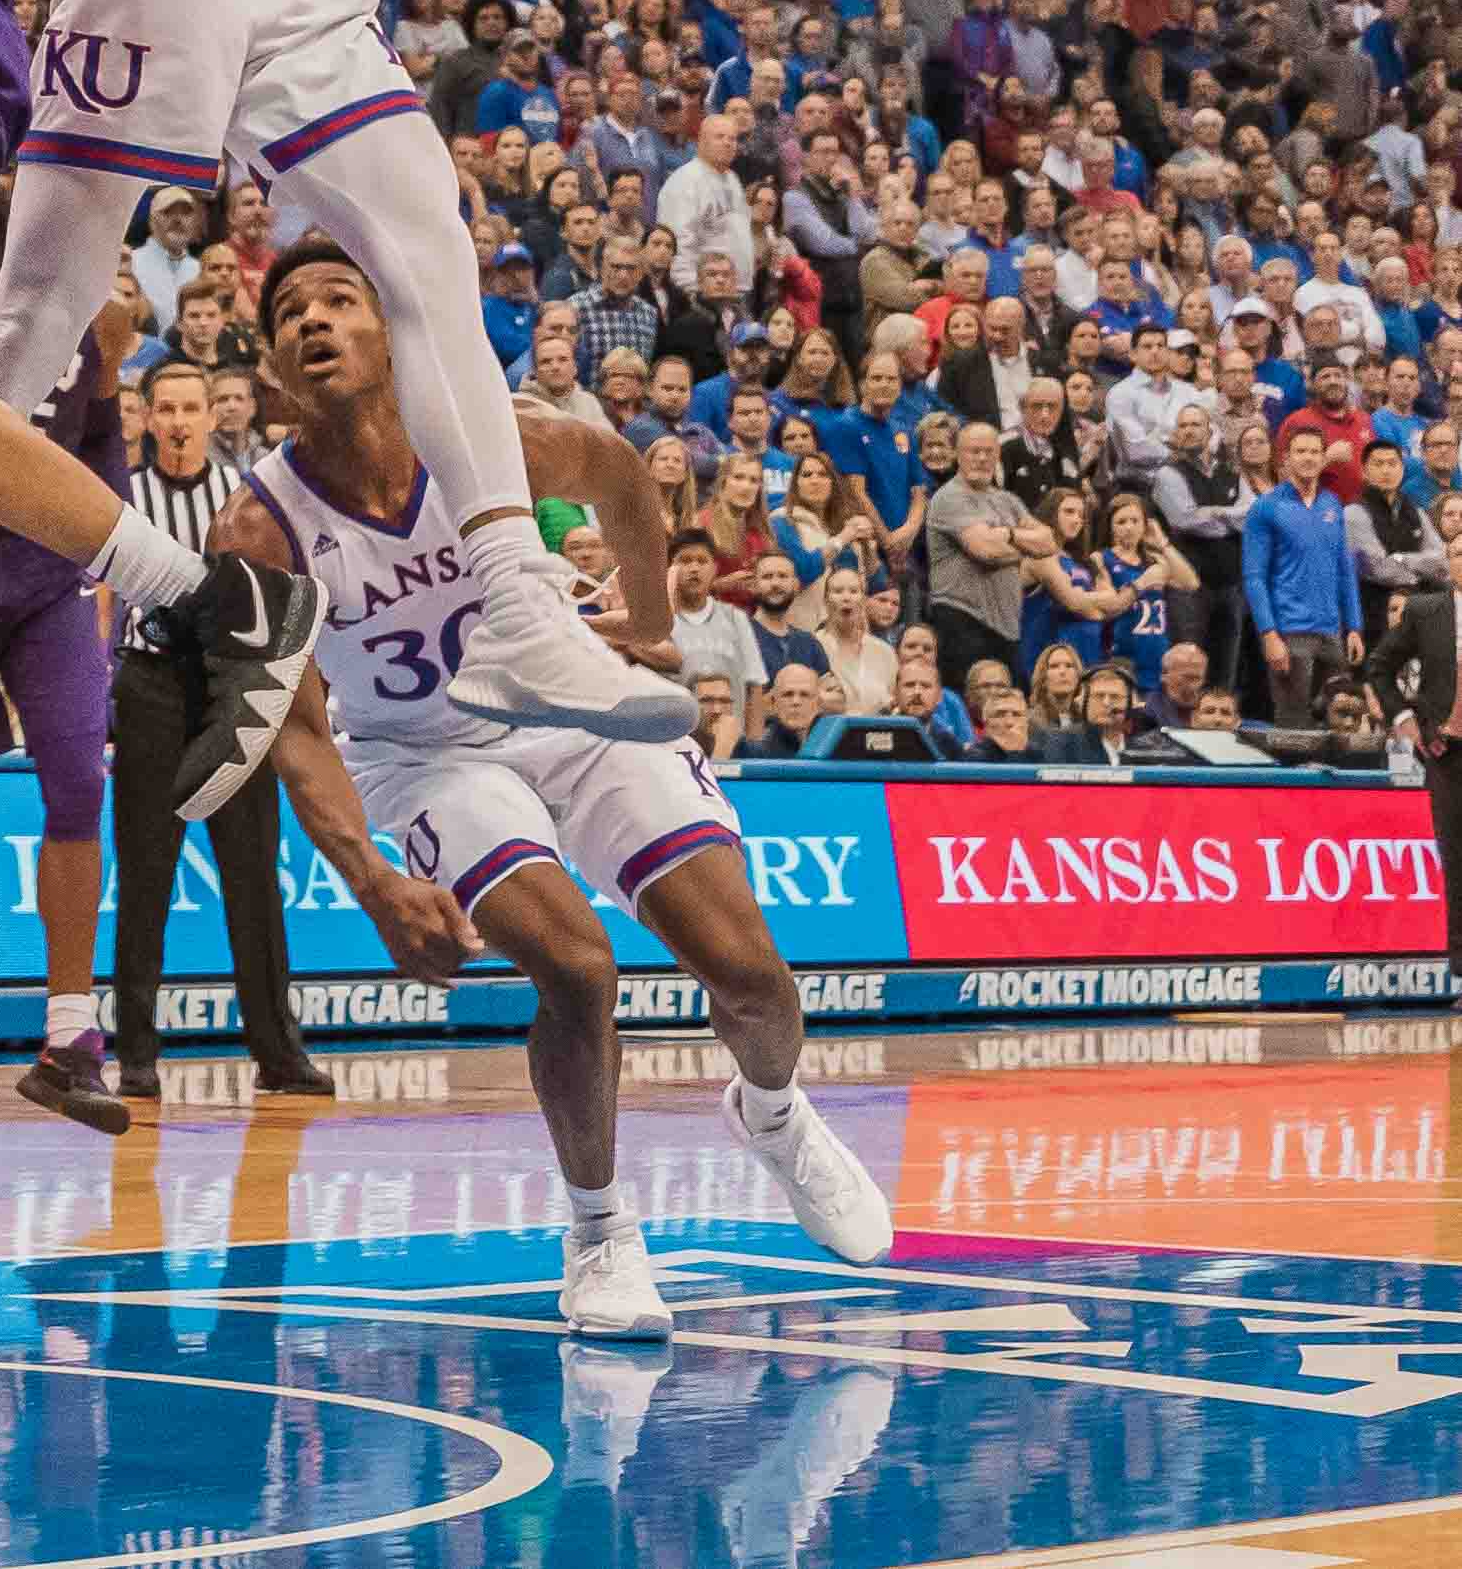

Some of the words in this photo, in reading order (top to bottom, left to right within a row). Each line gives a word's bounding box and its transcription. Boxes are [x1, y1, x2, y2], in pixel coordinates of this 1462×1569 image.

[40, 29, 151, 114] KU
[929, 836, 1240, 905] KANSAS
[977, 971, 1099, 1007] ROCKET
[1101, 966, 1261, 1004] MORTGAGE
[1341, 962, 1448, 998] ROCKET
